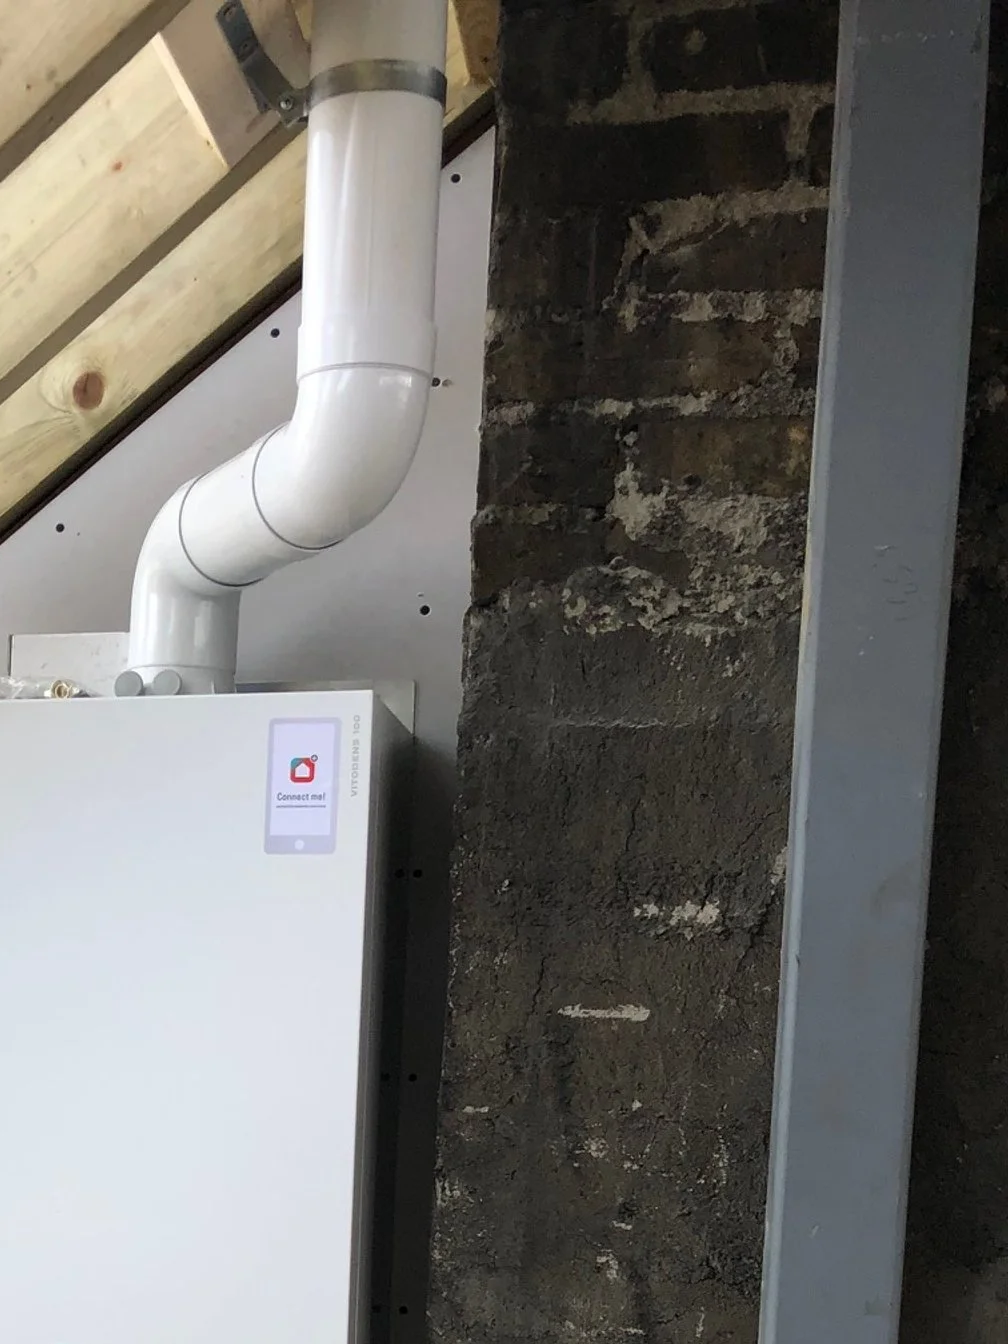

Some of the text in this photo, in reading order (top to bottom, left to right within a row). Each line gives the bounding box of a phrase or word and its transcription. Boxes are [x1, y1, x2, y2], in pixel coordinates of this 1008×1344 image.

[350, 714, 361, 798] VITODENS 100
[277, 792, 326, 801] Connect me!
